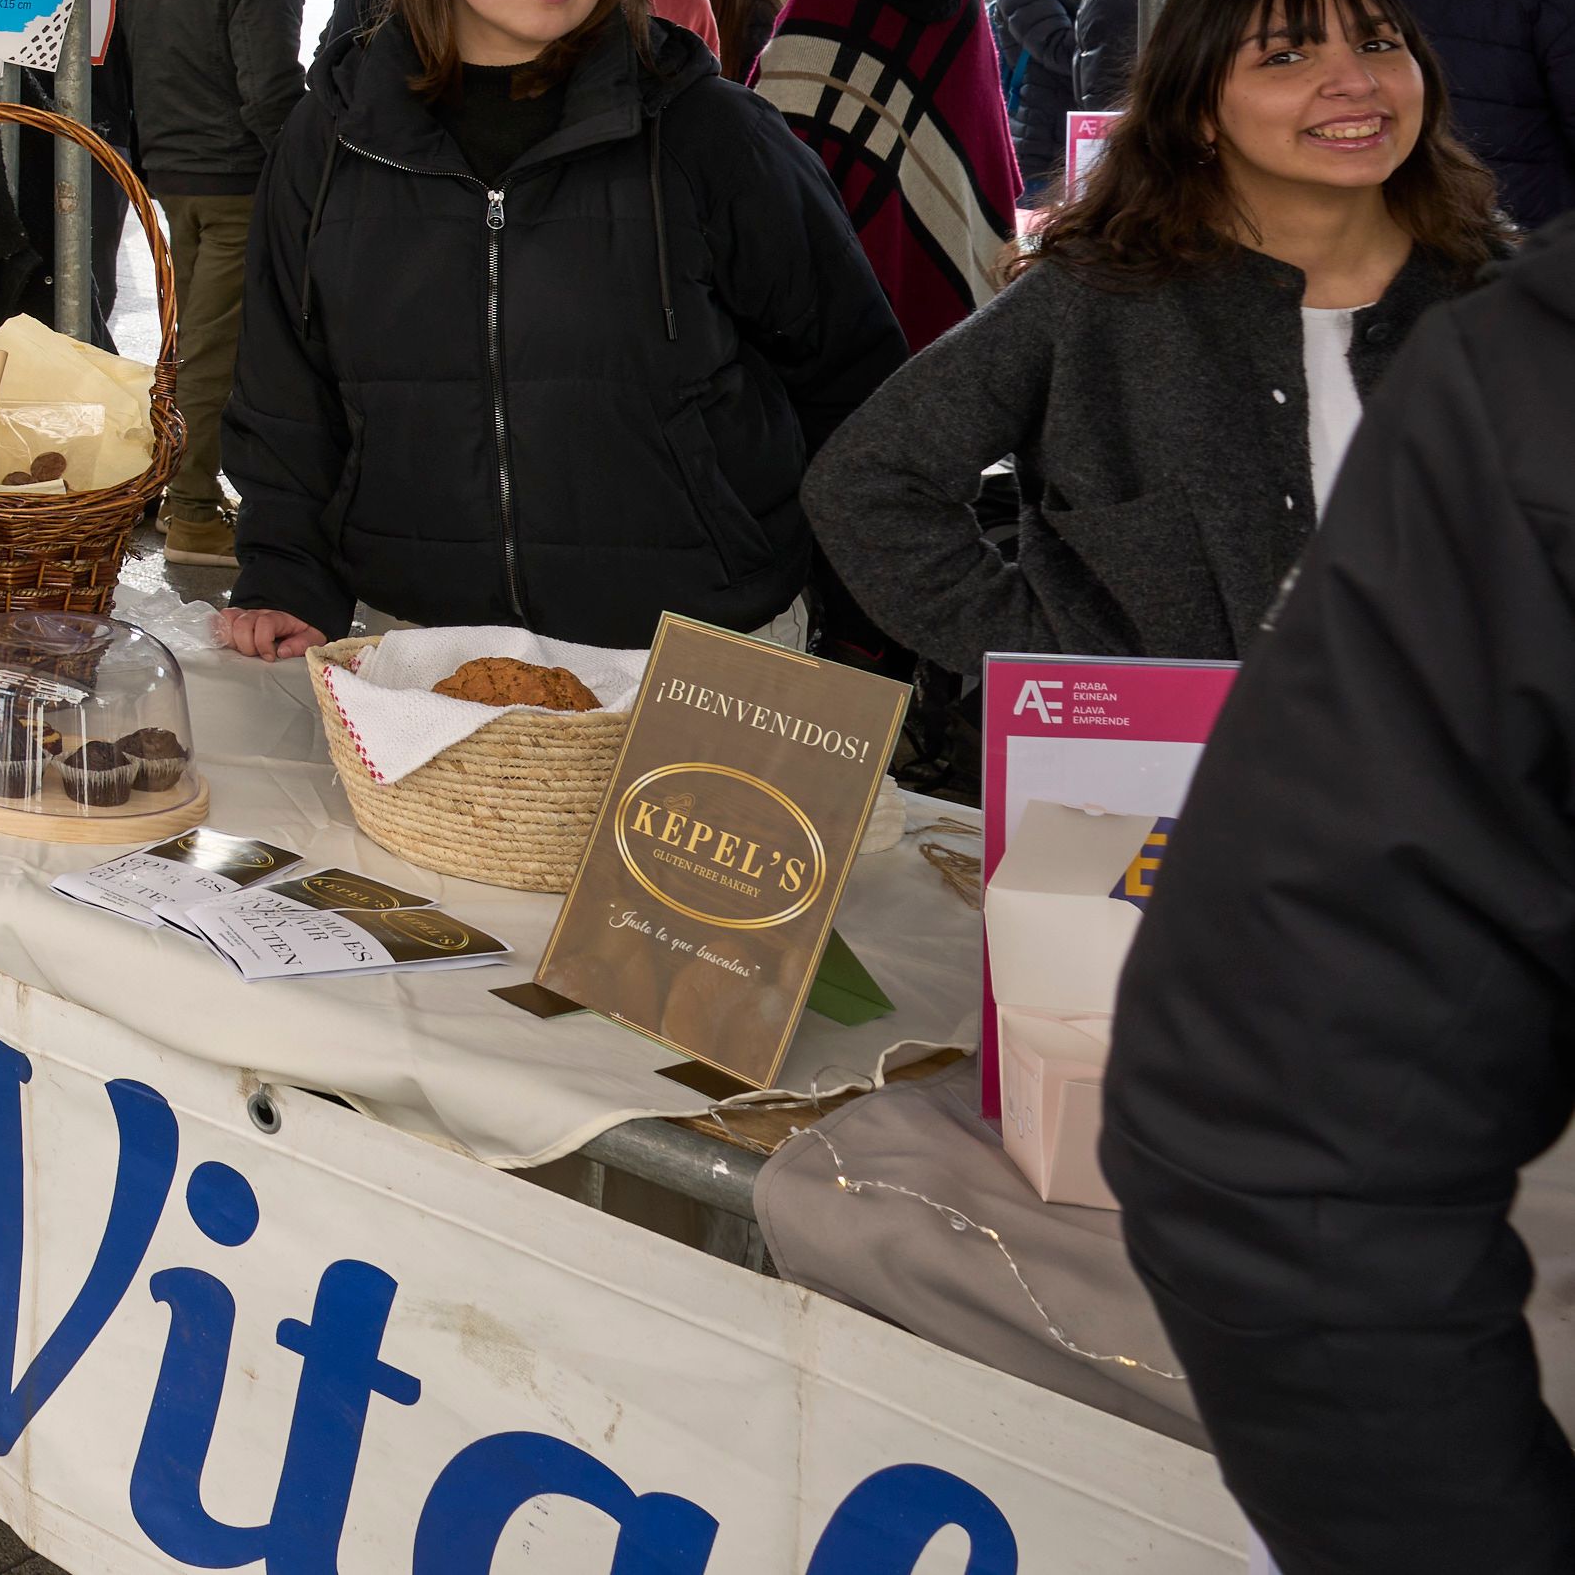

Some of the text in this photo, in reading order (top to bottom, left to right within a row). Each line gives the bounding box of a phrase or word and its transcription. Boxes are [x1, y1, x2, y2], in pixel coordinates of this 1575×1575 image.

[18, 0, 32, 10] cm
[1073, 682, 1108, 691] ARABA
[1073, 692, 1117, 701] EKINEAN
[655, 677, 870, 764] ¡BIENVENIDOS!
[1073, 716, 1130, 726] EMPRENDE
[652, 848, 762, 898] GLUTEN FREE BAKERY
[655, 925, 668, 943] lo
[670, 937, 694, 957] que
[343, 941, 374, 963] ES
